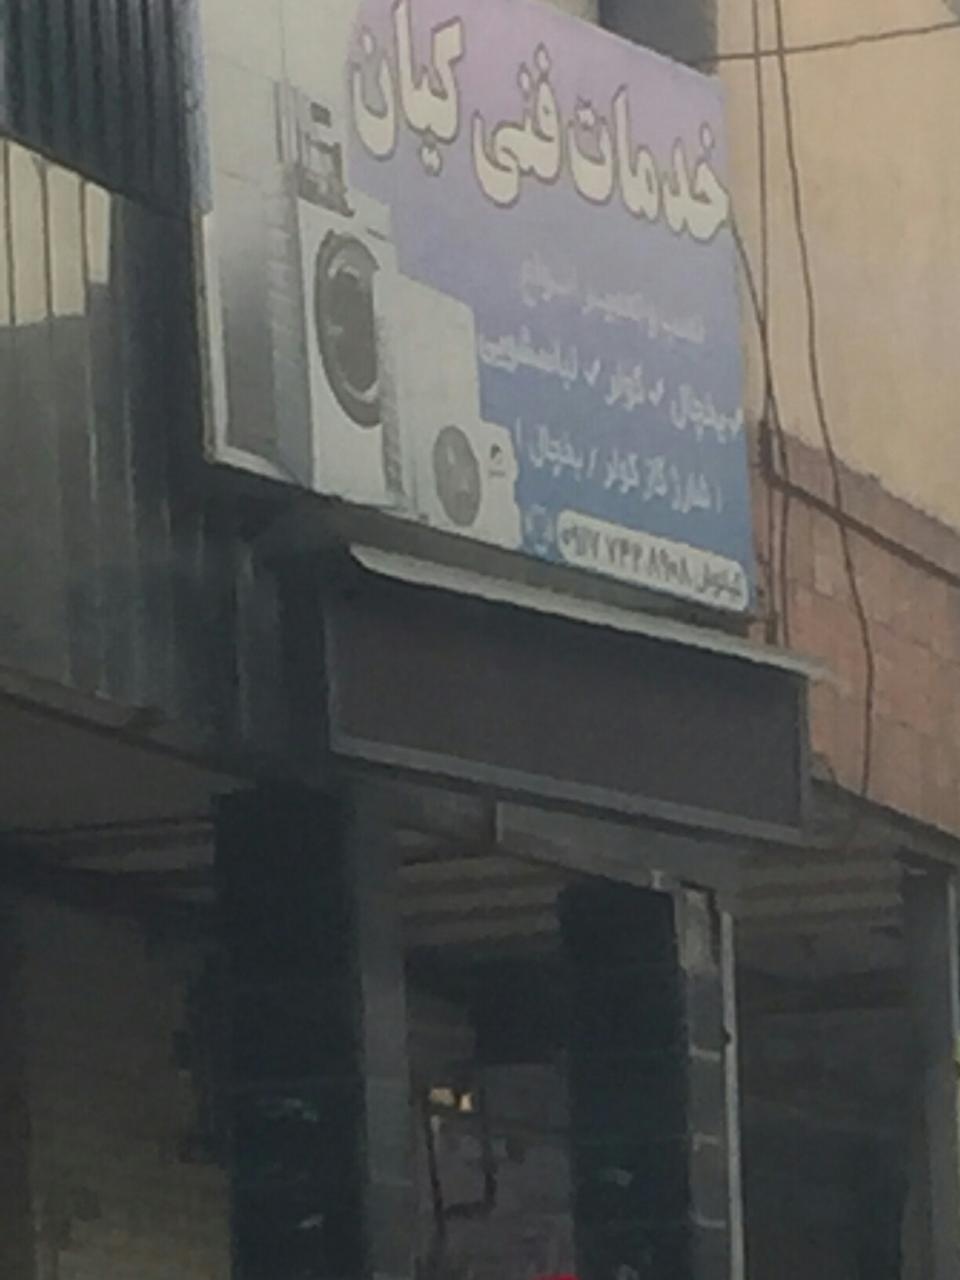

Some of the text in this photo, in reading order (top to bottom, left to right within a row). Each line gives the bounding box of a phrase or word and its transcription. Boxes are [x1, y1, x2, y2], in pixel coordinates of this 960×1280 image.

[350, 0, 730, 244] خدمات فنی کیان
